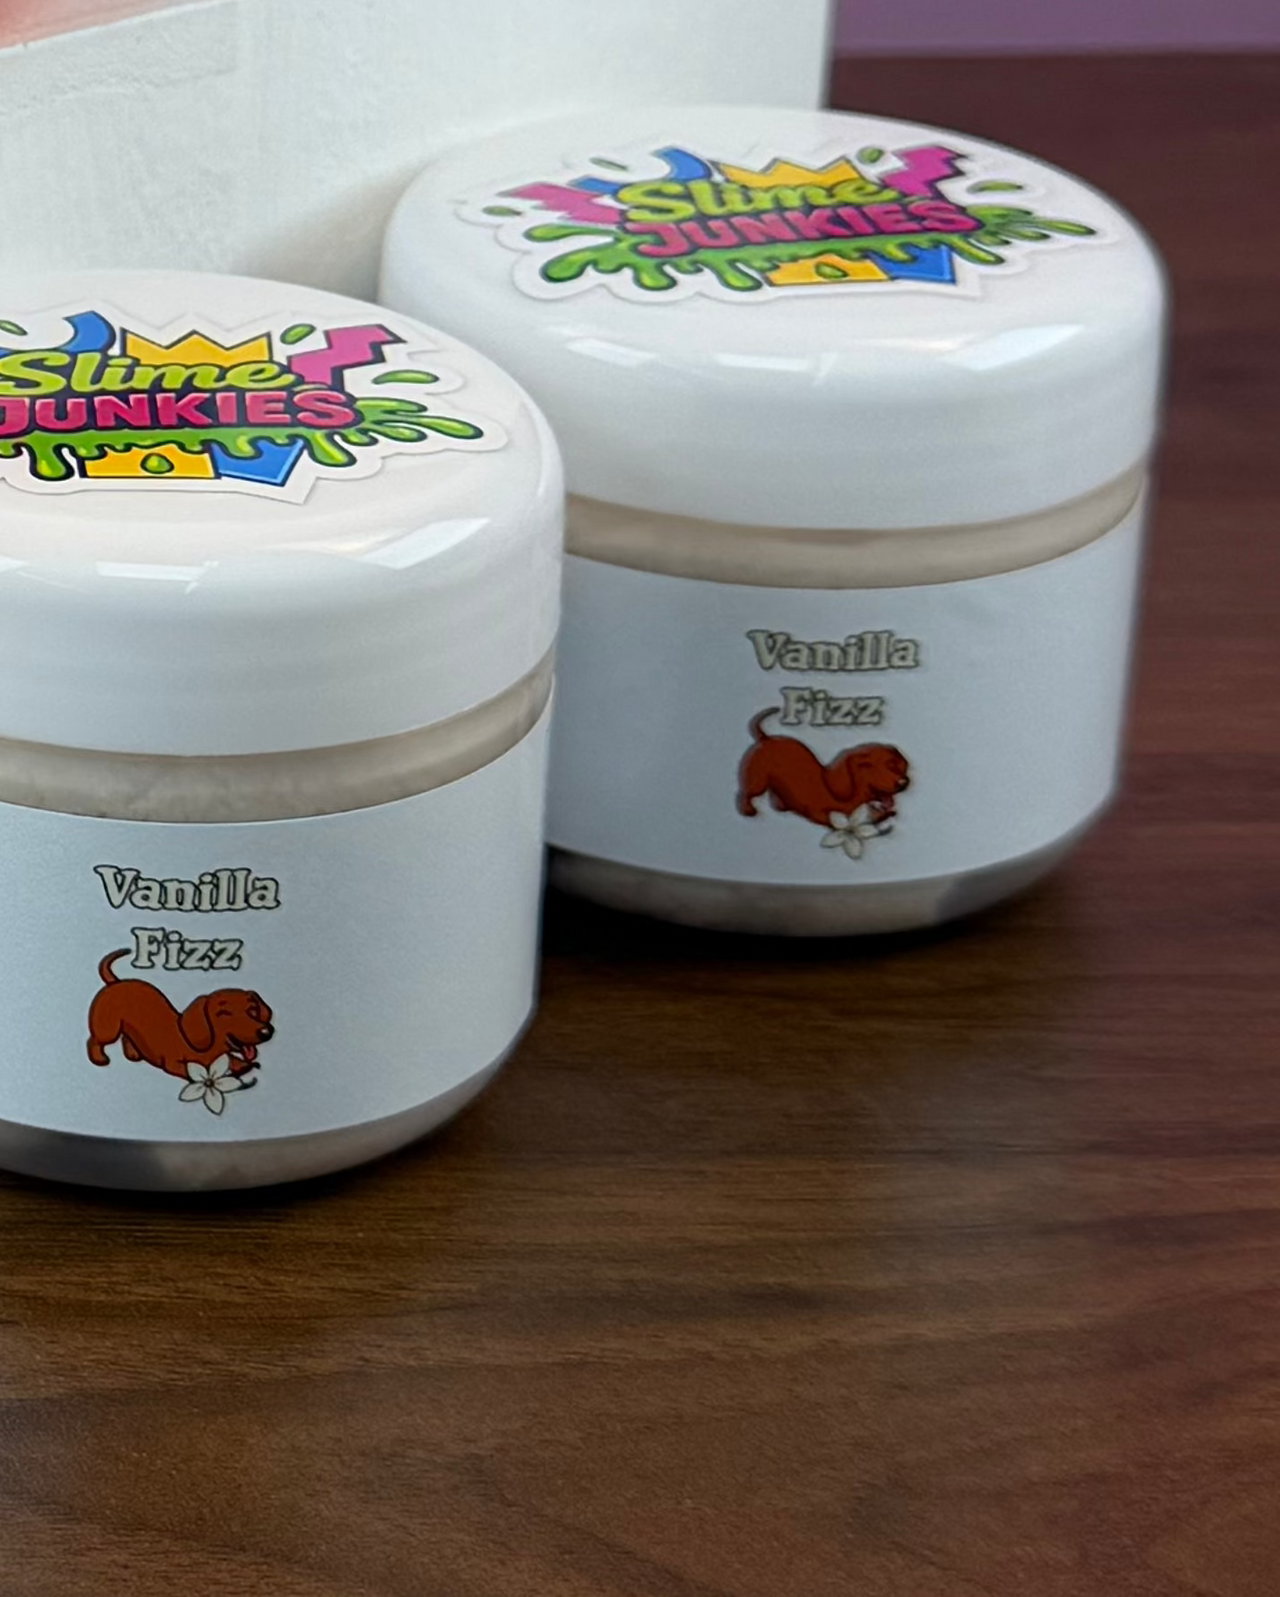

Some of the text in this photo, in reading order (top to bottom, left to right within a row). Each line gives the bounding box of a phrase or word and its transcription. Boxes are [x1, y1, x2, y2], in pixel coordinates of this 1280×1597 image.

[616, 177, 895, 223] Slime
[628, 202, 983, 257] JUNKIES
[746, 629, 921, 672] Vanilla
[780, 686, 885, 727] Fizz
[93, 864, 281, 912] Vanilla
[130, 926, 244, 971] Fizz
